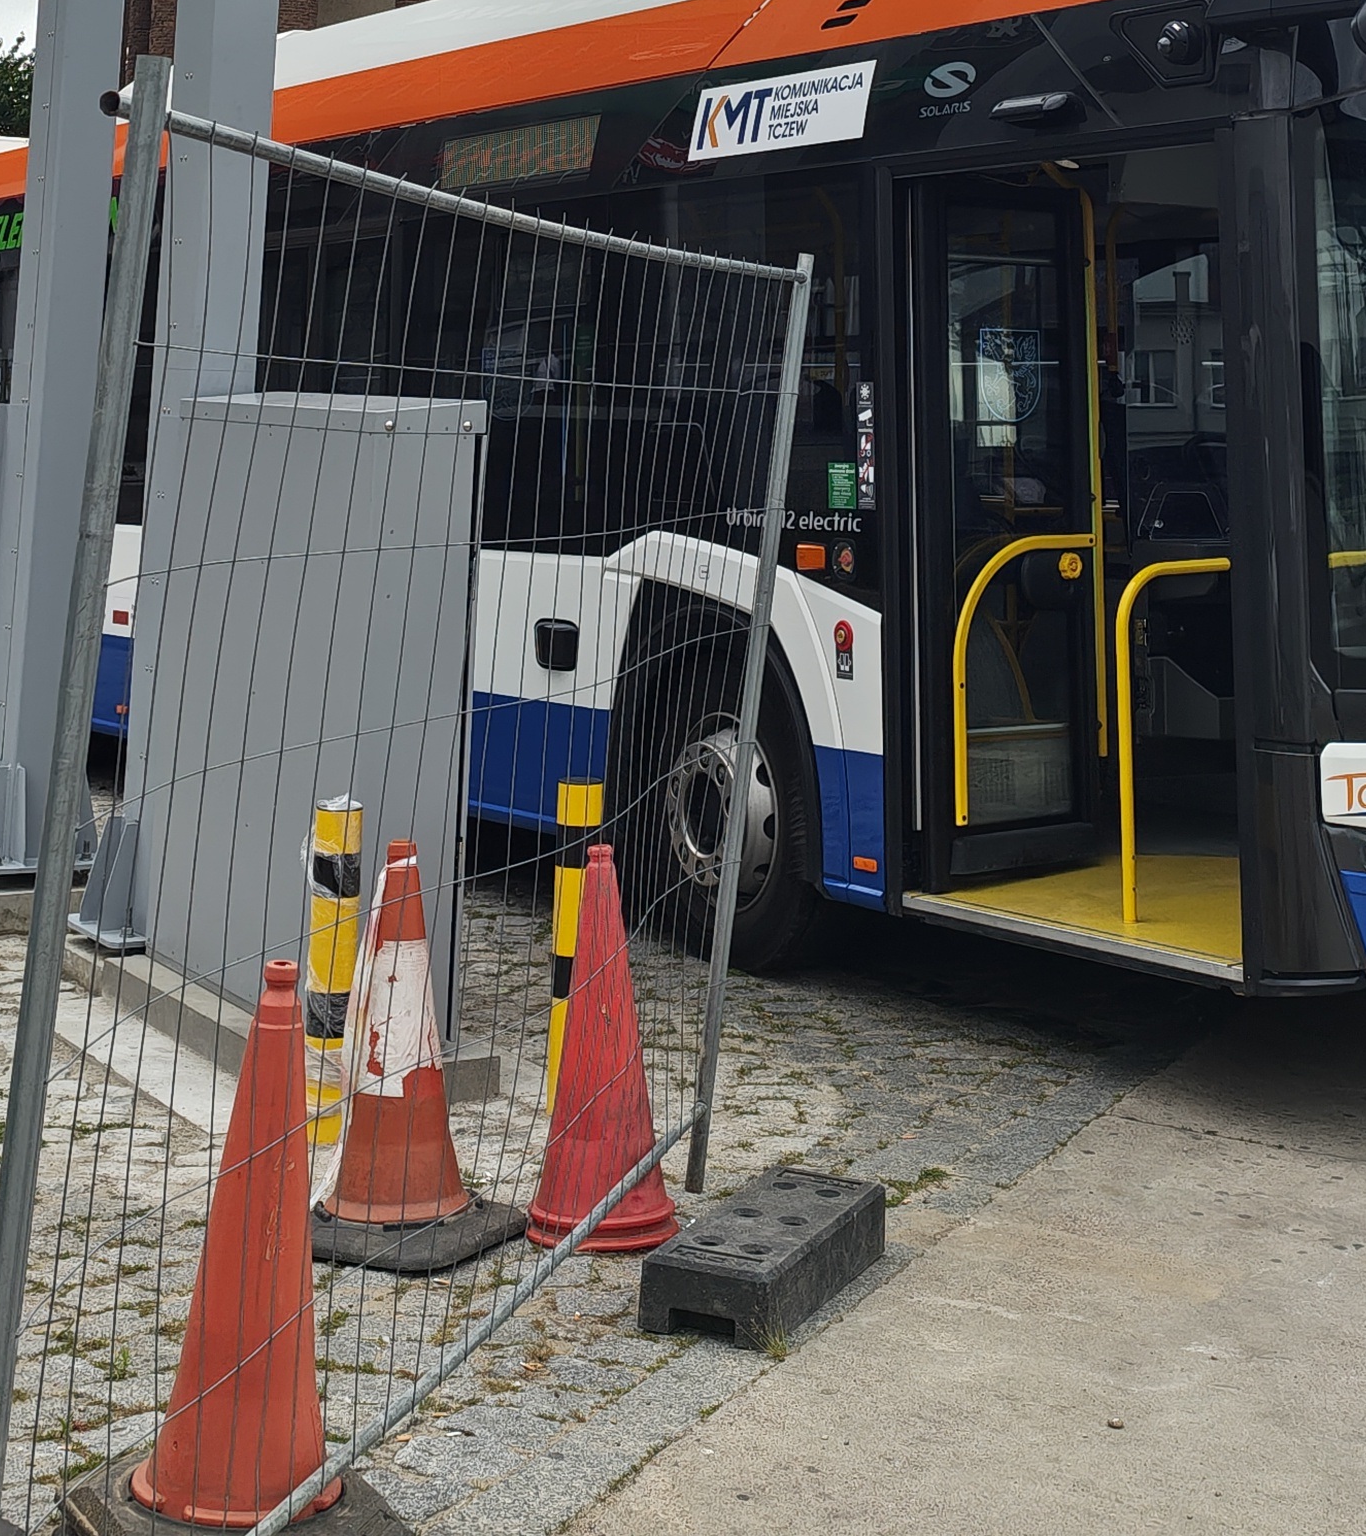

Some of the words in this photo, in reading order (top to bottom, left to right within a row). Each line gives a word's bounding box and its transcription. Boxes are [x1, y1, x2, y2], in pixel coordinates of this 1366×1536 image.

[772, 72, 865, 103] KOMUNIKACJA
[696, 87, 774, 151] KMT
[769, 98, 819, 122] MIEJSKA
[919, 101, 971, 118] SOLARIS
[767, 119, 809, 141] TCZEW
[726, 507, 765, 528] Urbin
[799, 511, 862, 533] electric
